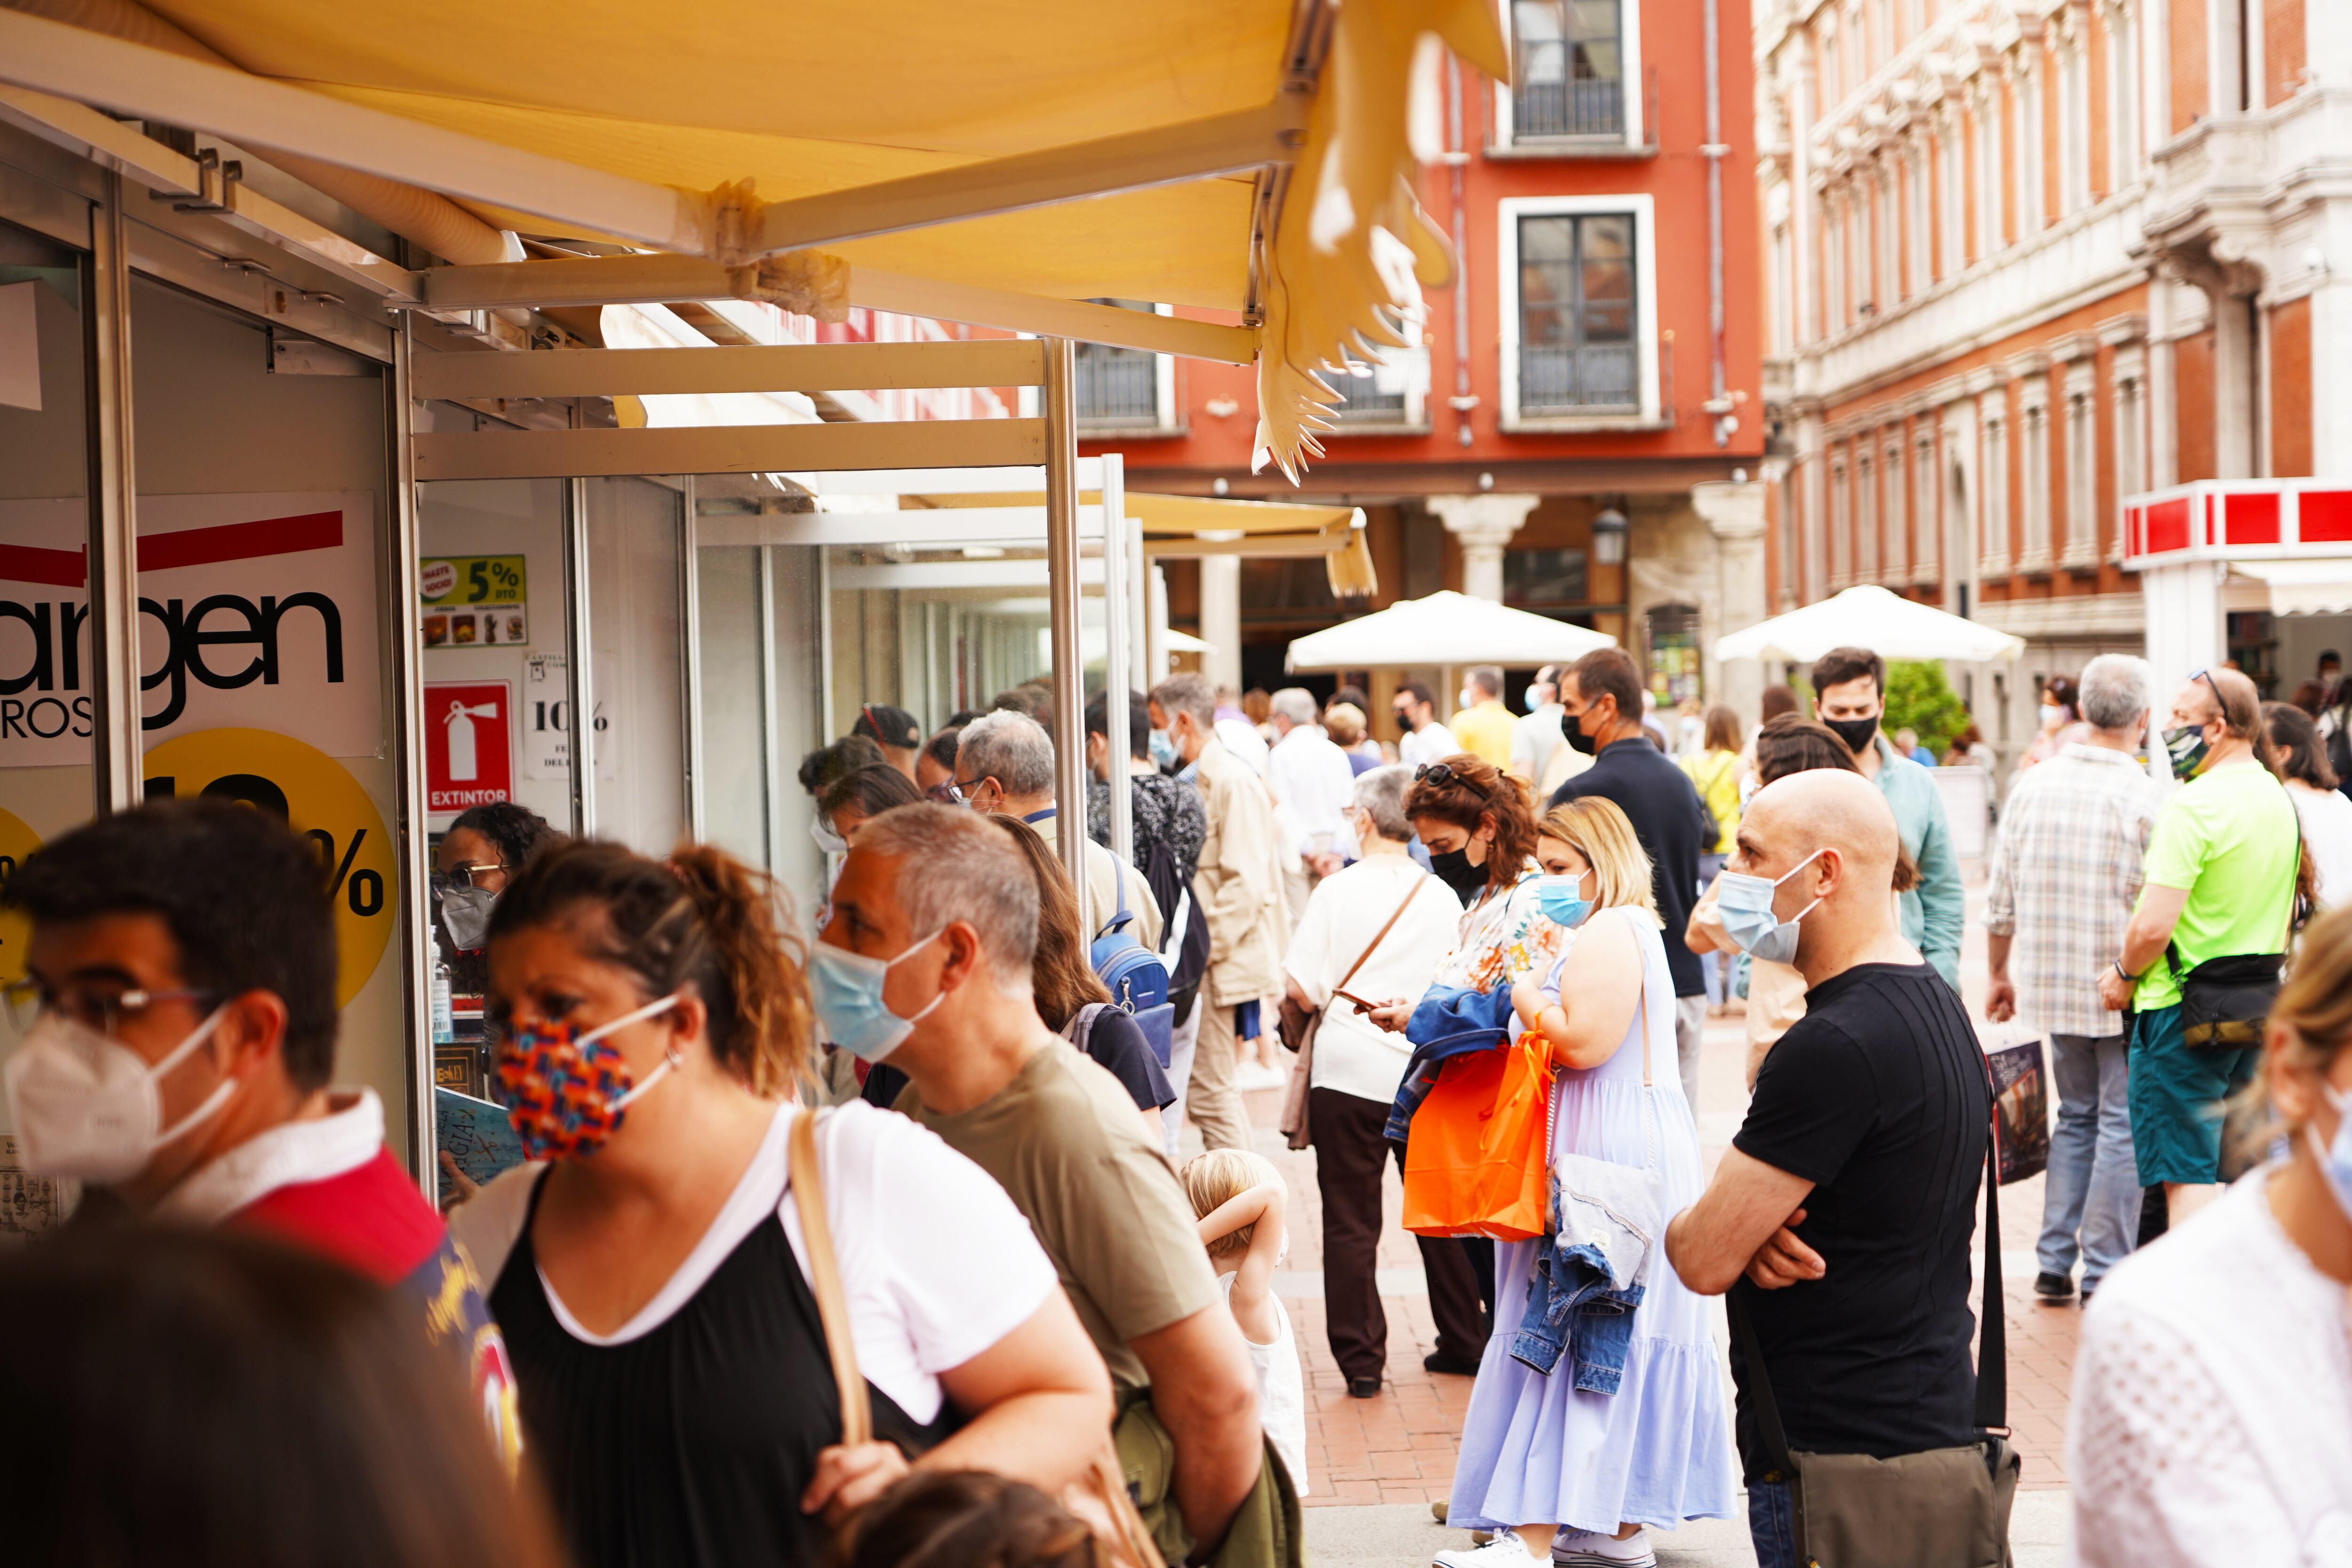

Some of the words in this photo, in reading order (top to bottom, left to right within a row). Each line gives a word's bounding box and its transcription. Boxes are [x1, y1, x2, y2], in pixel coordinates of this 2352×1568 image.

[468, 560, 519, 602] 5%
[495, 589, 516, 599] DTO
[431, 789, 506, 806] EXTINTOR
